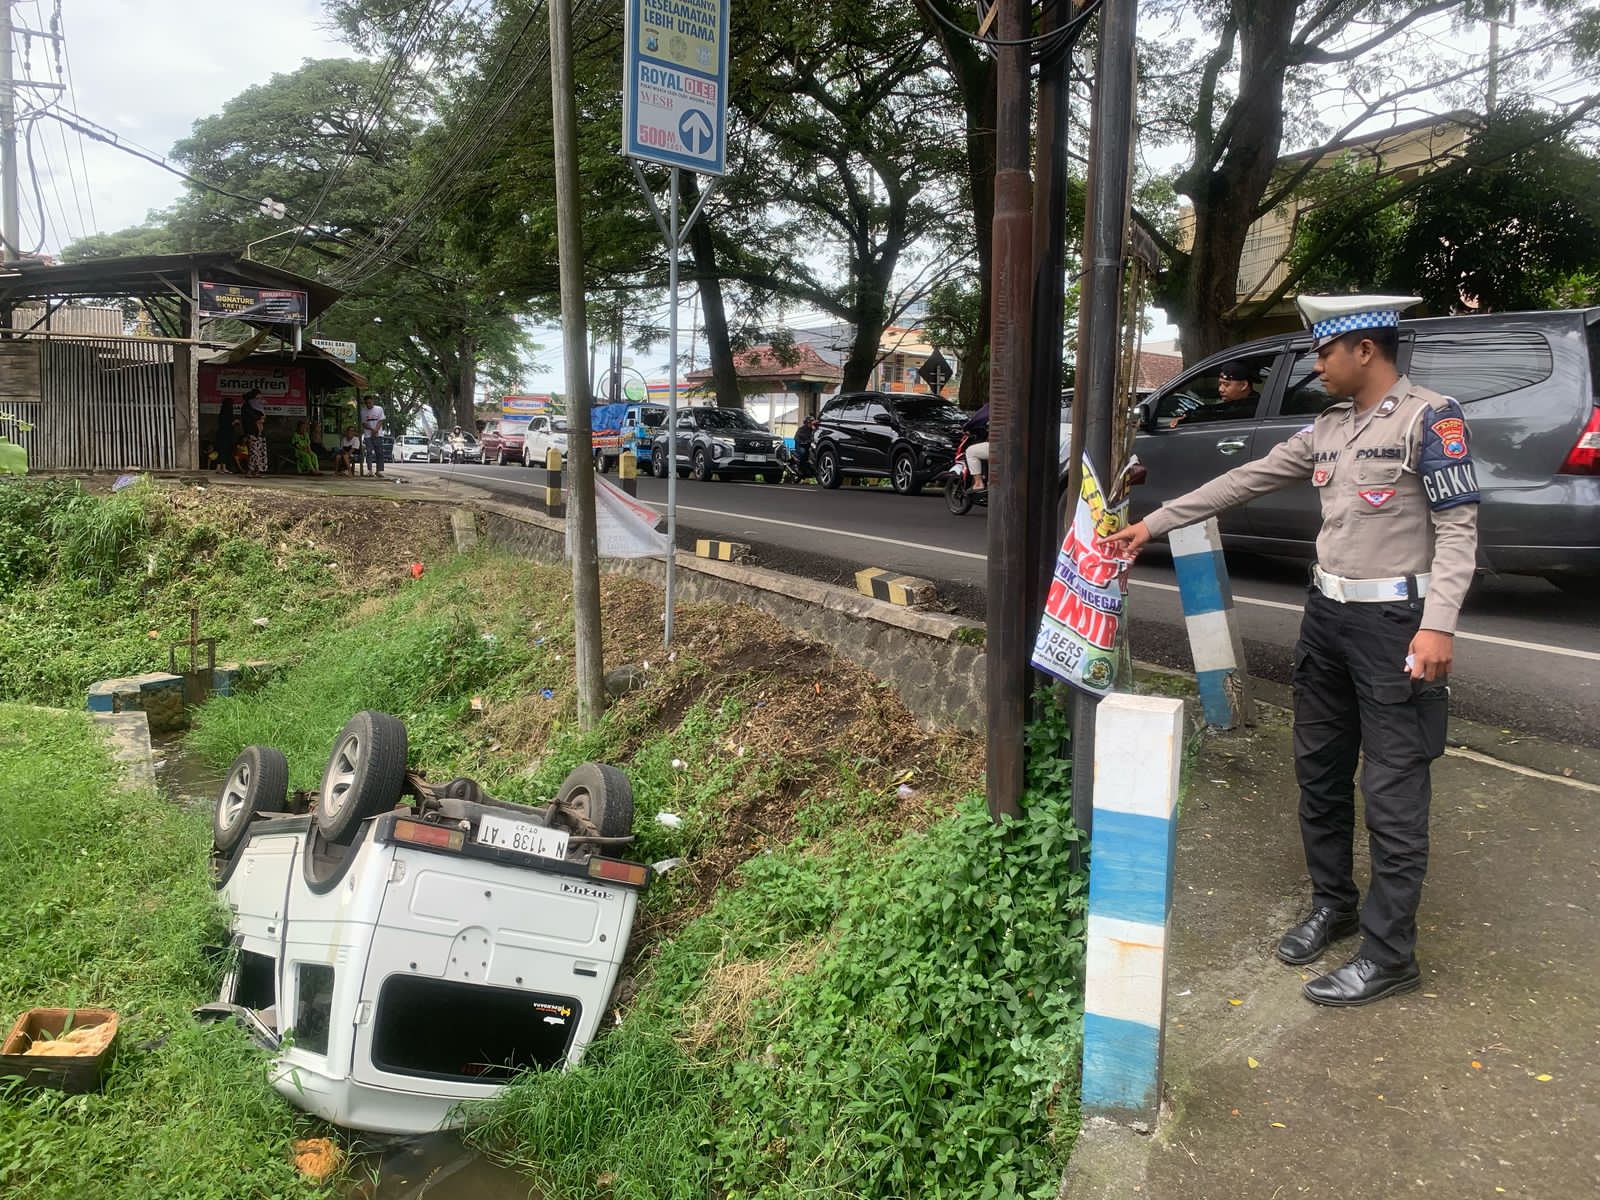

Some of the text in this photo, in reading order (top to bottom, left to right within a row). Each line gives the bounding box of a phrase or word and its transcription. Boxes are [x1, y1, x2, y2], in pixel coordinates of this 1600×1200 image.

[644, 9, 716, 44] LEBIH UTAMA
[640, 65, 684, 92] ROYAL
[215, 295, 255, 305] SIGNATURE
[219, 377, 287, 390] smartfren
[1356, 447, 1401, 459] POLISI
[1045, 578, 1120, 649] ANJIR
[1036, 640, 1079, 670] UNGLI
[481, 824, 565, 858] N 1138 AT
[560, 882, 614, 900] SUZUKI
